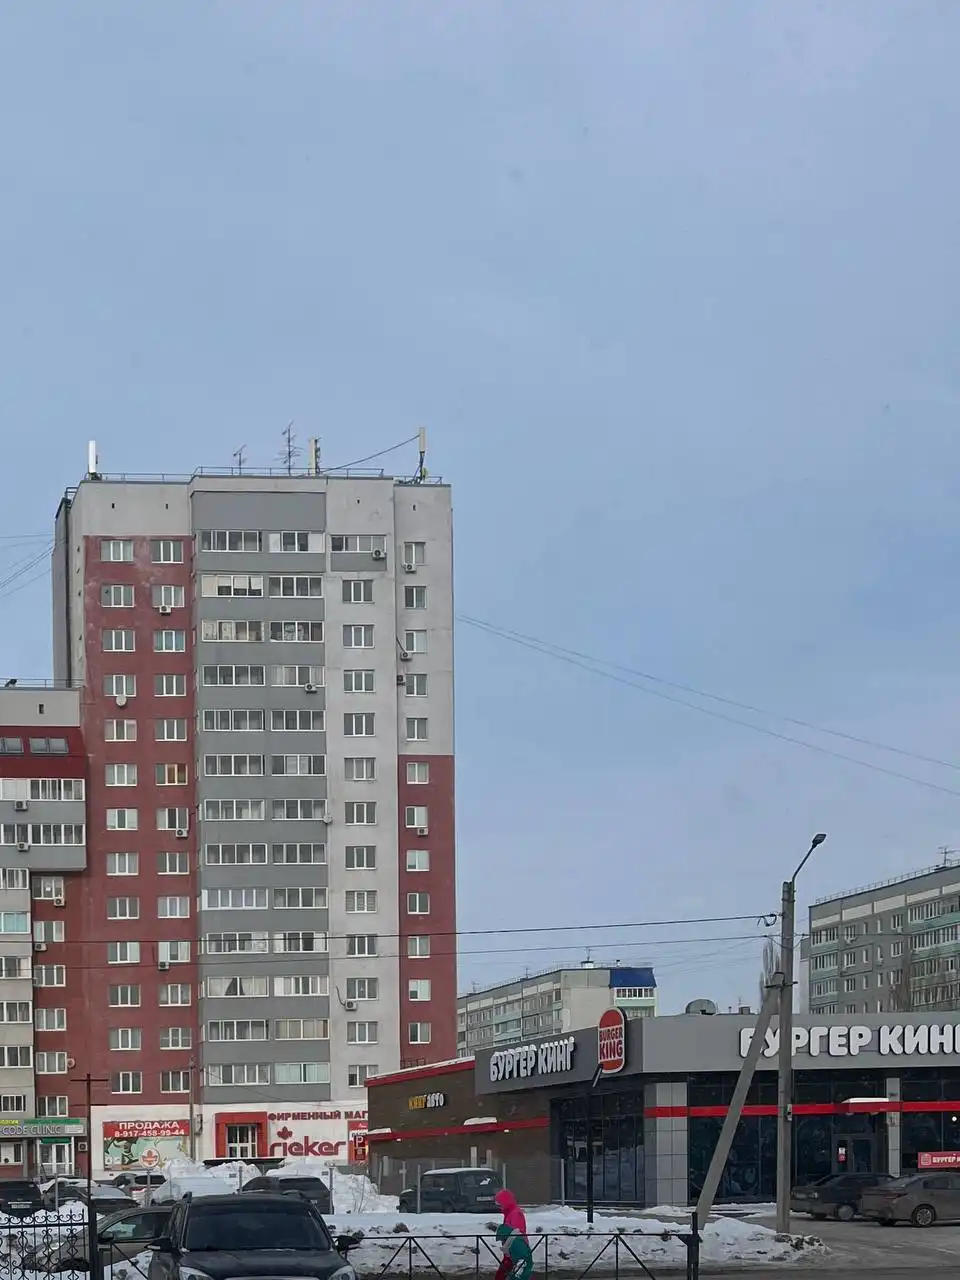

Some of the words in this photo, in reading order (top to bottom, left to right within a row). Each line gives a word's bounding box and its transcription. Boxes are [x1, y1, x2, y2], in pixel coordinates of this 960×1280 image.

[600, 1026, 623, 1041] BURGER
[879, 1024, 960, 1055] КИН
[600, 1039, 623, 1059] KING
[490, 1044, 537, 1081] БУРГЕР
[538, 1036, 574, 1074] КИНГ
[268, 1110, 341, 1120] ФИРМЕННЫЙ
[345, 1110, 368, 1120] МАГ
[114, 1128, 185, 1138] 8-917-458-99-44
[119, 1121, 180, 1130] ПРОДАЖА
[269, 1135, 346, 1157] rieker
